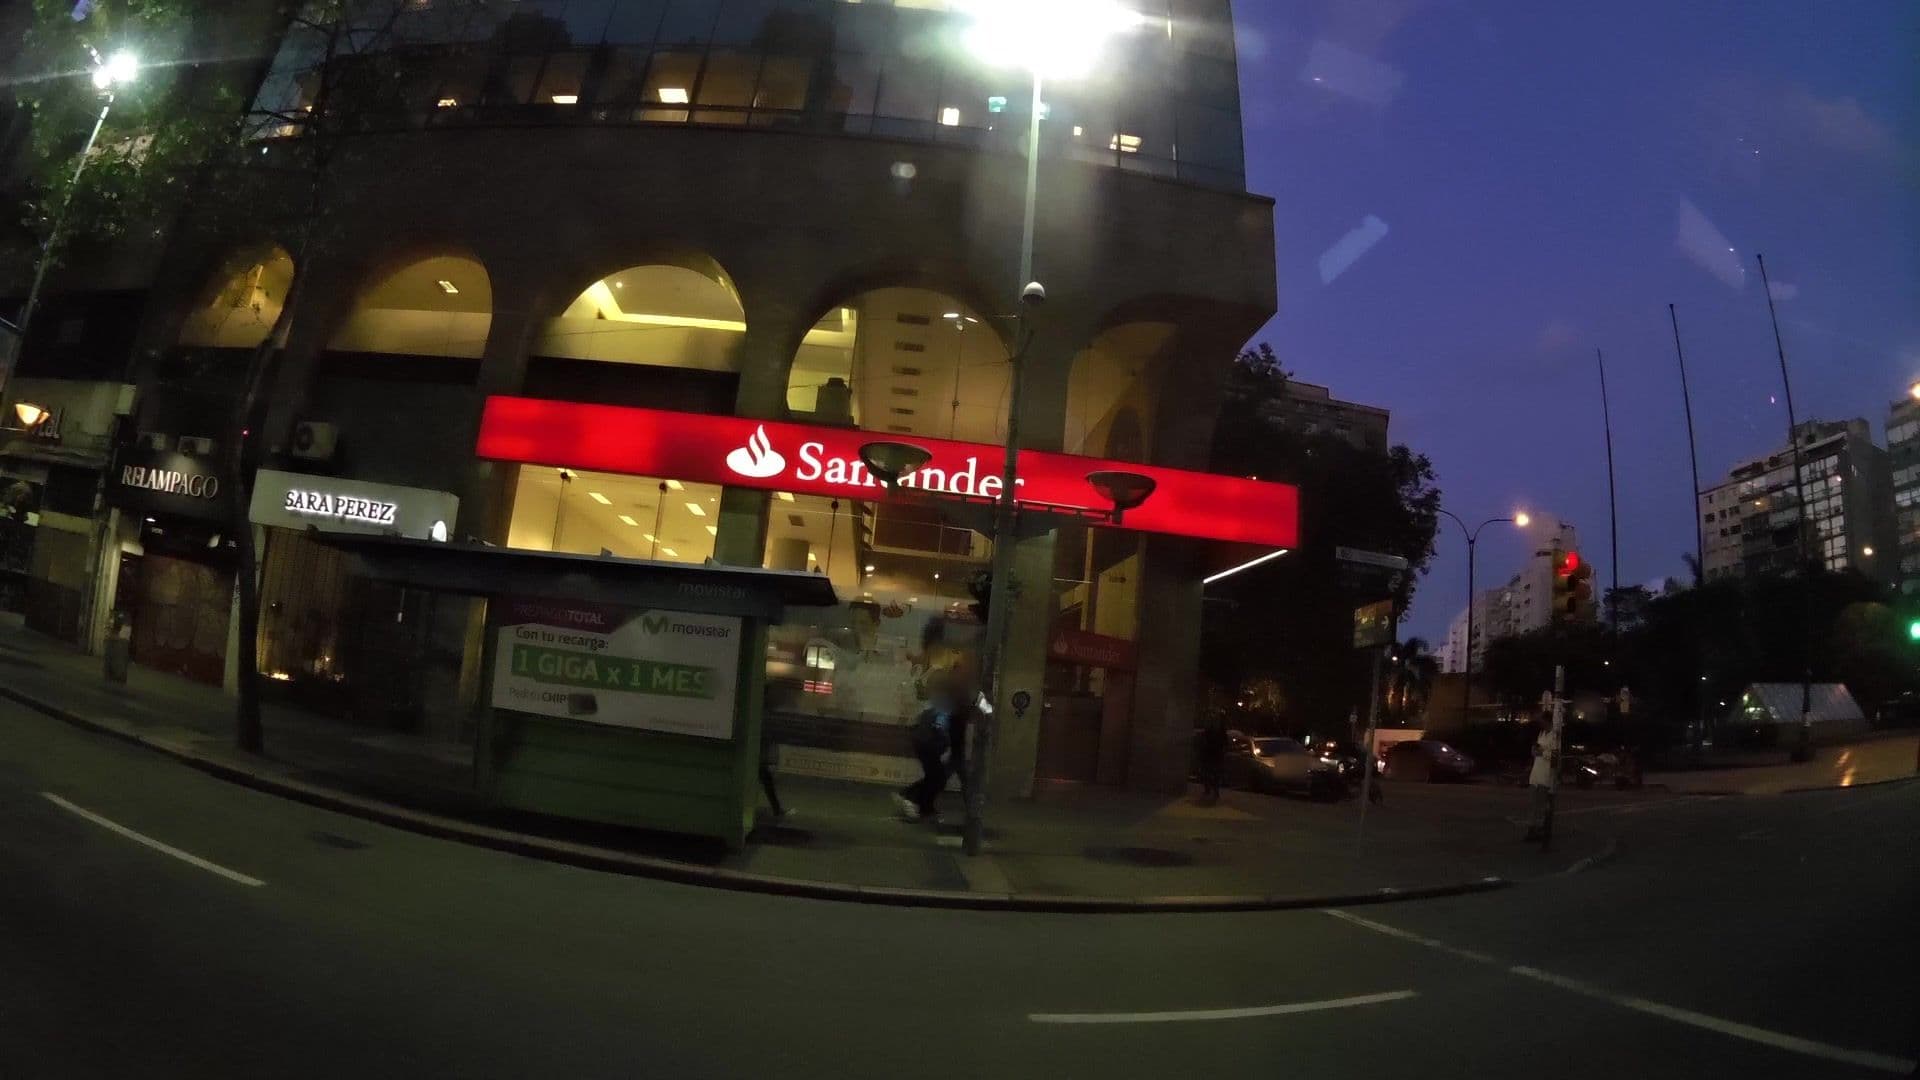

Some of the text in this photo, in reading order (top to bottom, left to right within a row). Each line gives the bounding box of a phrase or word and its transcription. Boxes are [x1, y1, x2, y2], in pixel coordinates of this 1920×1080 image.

[121, 465, 218, 498] RELAMPAGO
[285, 491, 395, 522] SARA PEREZ
[515, 626, 609, 651] Con tu recarga:
[671, 622, 730, 639] movistar
[518, 649, 530, 672] 1
[538, 653, 599, 681] GIGA
[631, 664, 642, 687] 1
[652, 668, 706, 693] MES
